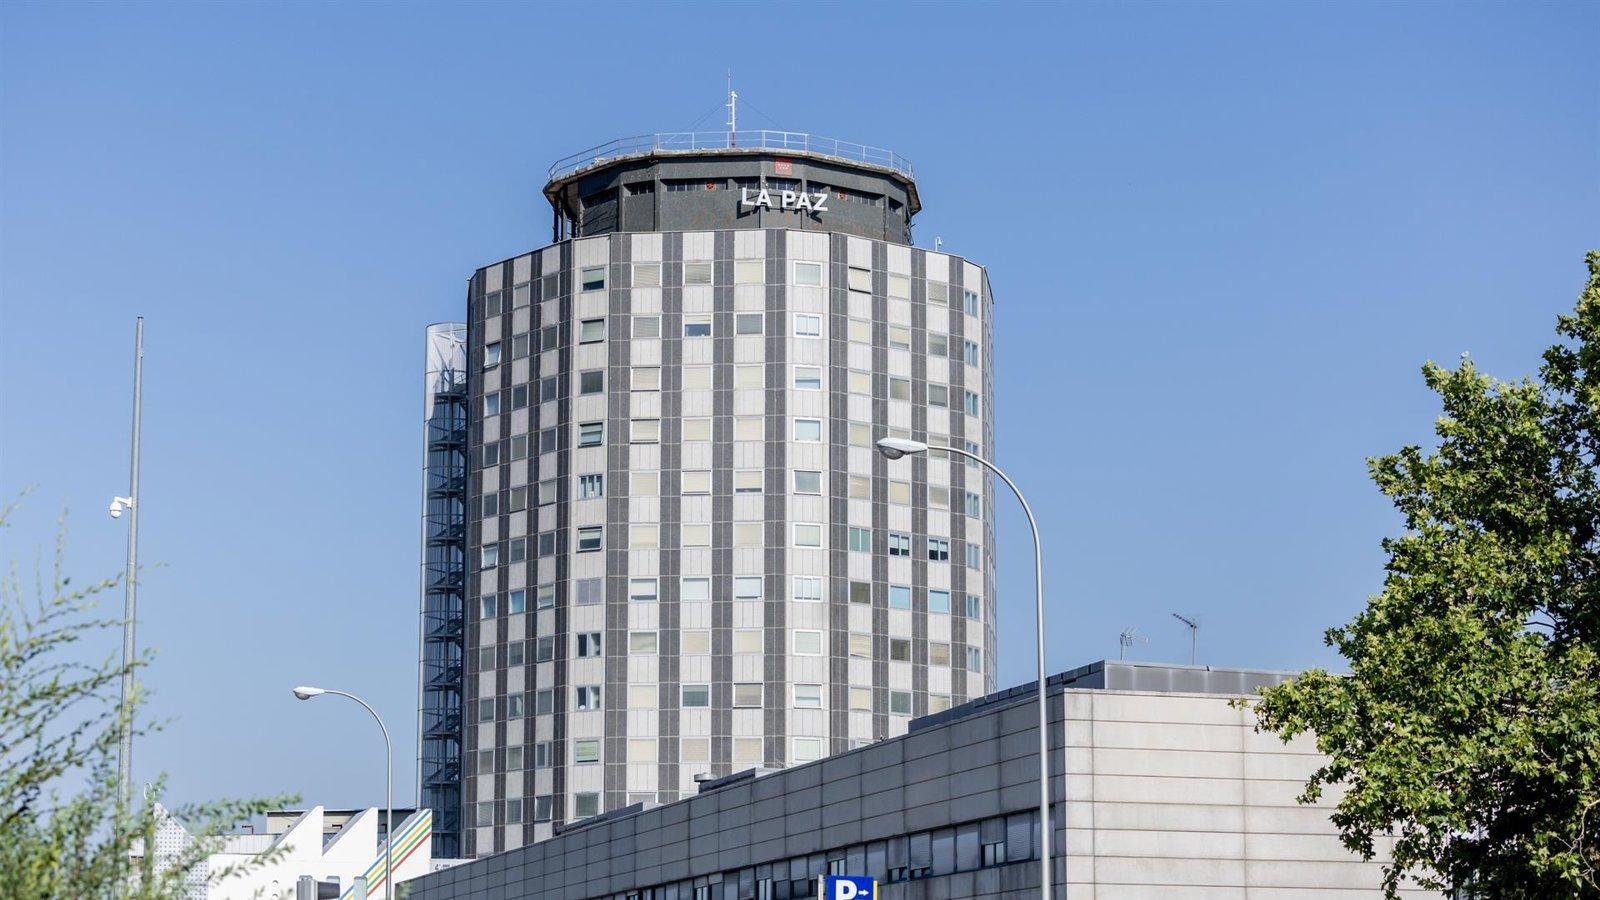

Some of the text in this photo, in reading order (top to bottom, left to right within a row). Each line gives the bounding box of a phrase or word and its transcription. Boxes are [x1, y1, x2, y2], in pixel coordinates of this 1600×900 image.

[741, 187, 828, 211] LA PAZ
[835, 879, 858, 900] P
